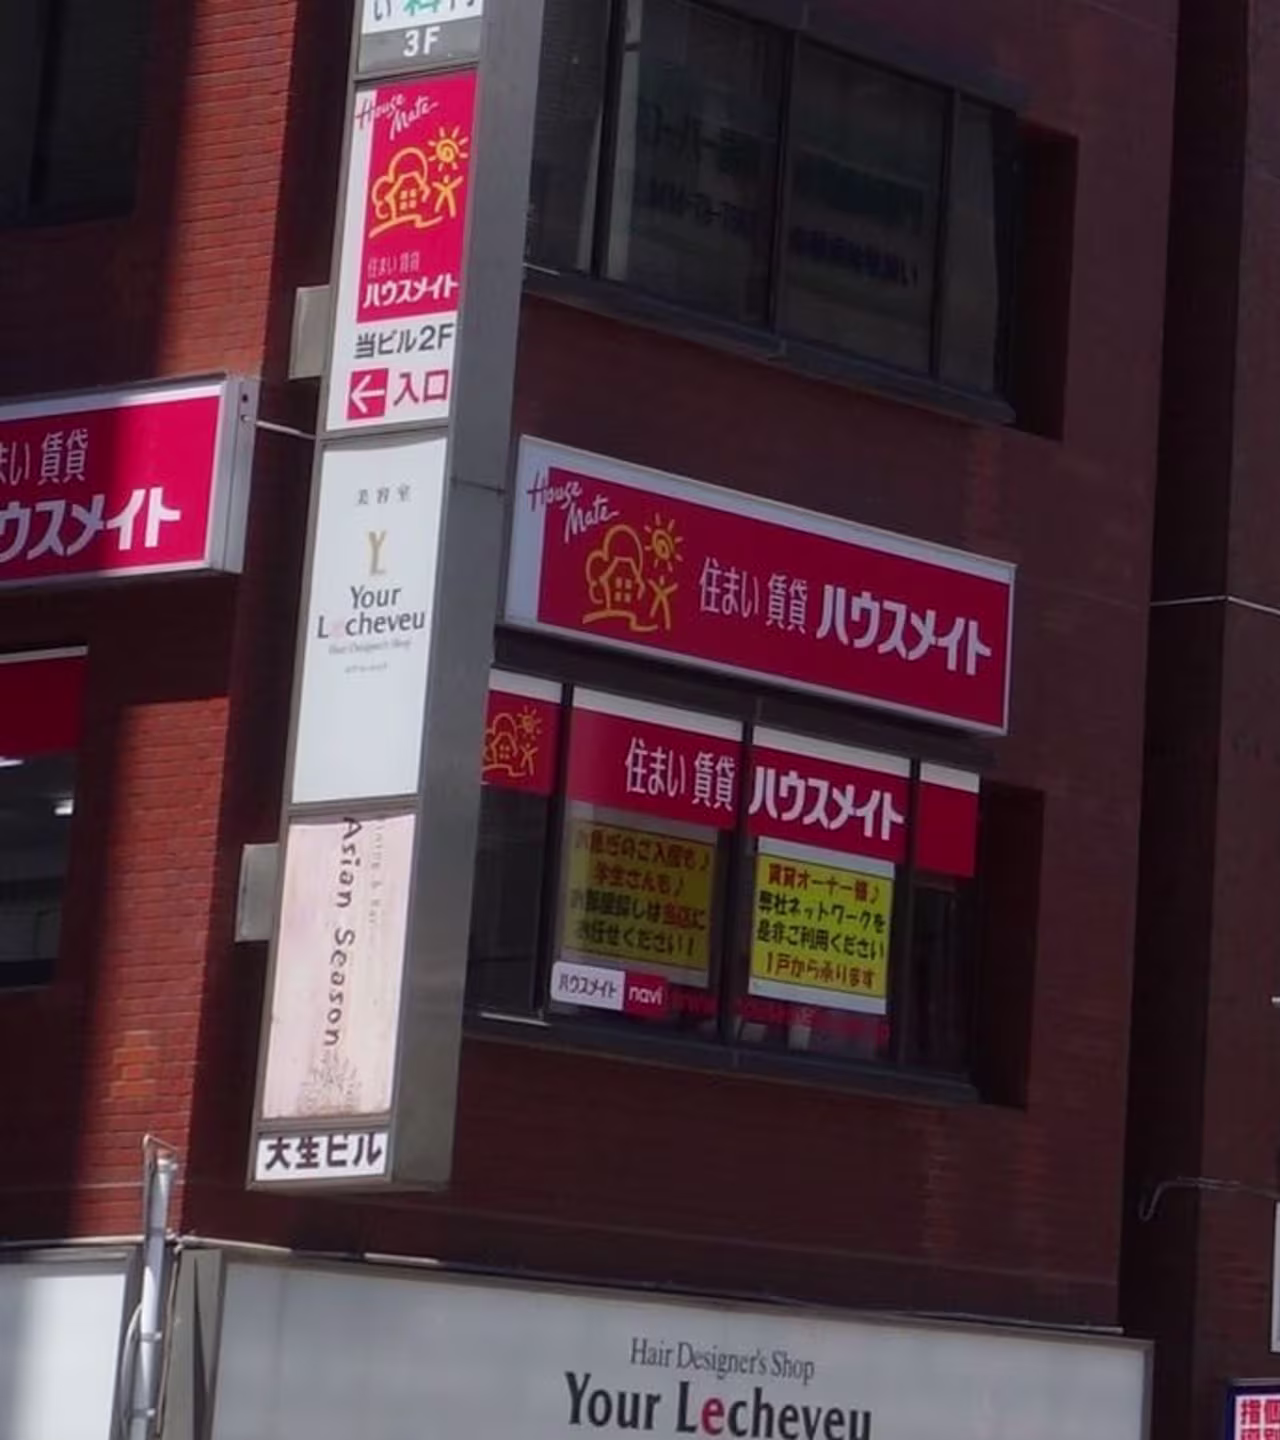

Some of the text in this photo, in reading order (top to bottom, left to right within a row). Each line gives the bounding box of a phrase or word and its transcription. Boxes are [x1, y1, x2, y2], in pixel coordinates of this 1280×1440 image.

[402, 26, 441, 57] 3F
[355, 94, 406, 130] House
[390, 101, 439, 141] Mate
[363, 273, 459, 309] ハウスメイト
[355, 323, 455, 359] 当ビル2F
[393, 370, 449, 406] 入口
[38, 428, 88, 485] 賃貸
[526, 473, 582, 512] House
[565, 496, 618, 543] Mate
[350, 584, 401, 610] Your
[700, 557, 991, 675] 住まい 賃貸 ハウスメイト
[625, 738, 904, 840] 住まい 賃貸 ハウスメイト
[324, 817, 363, 1046] Asian Season
[558, 971, 663, 1007] ハウスメイト navi
[264, 1133, 382, 1171] 大生ビル
[630, 1337, 815, 1386] Hair Designer's Shop
[564, 1370, 661, 1431] Your
